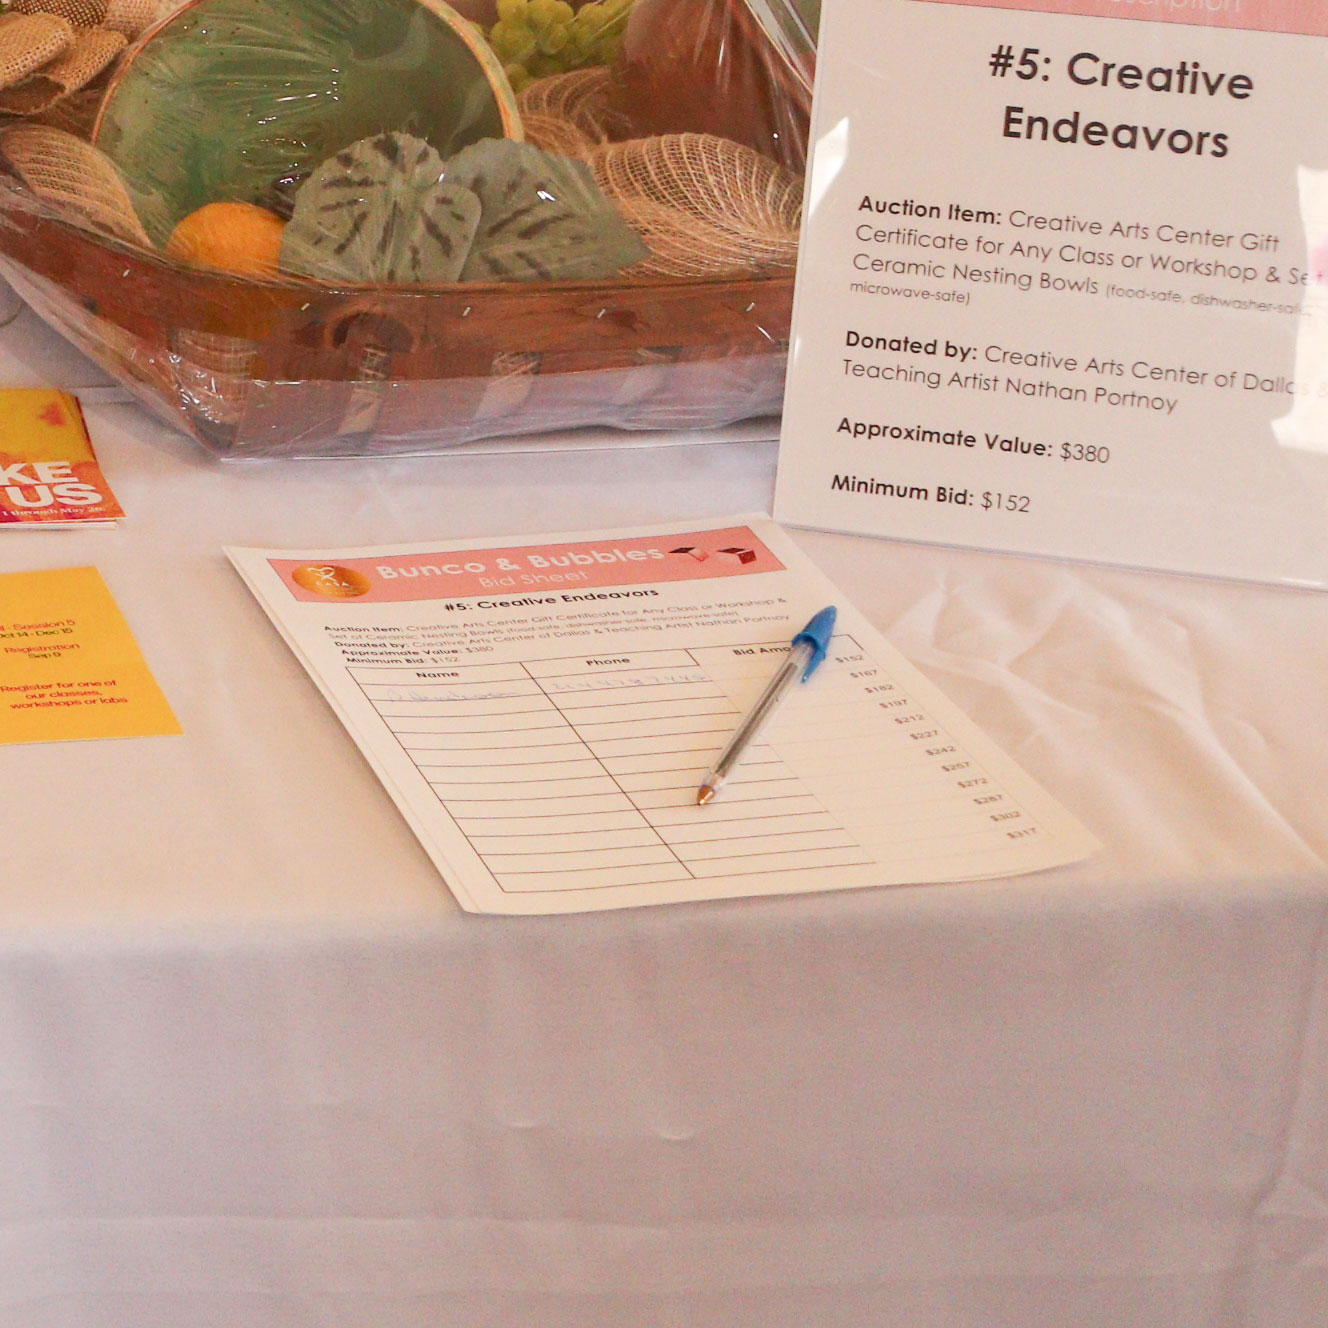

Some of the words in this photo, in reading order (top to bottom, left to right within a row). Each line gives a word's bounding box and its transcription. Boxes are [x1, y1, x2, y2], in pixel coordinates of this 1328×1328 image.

[989, 44, 1050, 81] #5:
[1067, 52, 1253, 100] Creative
[1003, 105, 1230, 158] Endeavors
[858, 196, 941, 219] Auction
[947, 204, 1002, 225] Item:
[1009, 210, 1102, 236] Creative
[1109, 221, 1149, 240] Arts
[1156, 225, 1234, 247] Center
[1240, 233, 1280, 252] Gift
[856, 224, 968, 253] Certificate
[976, 236, 1004, 256] for
[1010, 241, 1051, 264] Any
[1059, 244, 1114, 267] Class
[1121, 255, 1143, 268] or
[1150, 254, 1258, 283] Workshop
[1265, 267, 1281, 283] &
[1287, 268, 1311, 286] Se
[850, 281, 971, 305] microwave-safe)
[853, 254, 945, 279] Ceramic
[952, 263, 1032, 290] Nesting
[1040, 271, 1098, 295] Bowls
[1106, 284, 1185, 304] (food-safe,
[1190, 293, 1312, 316] dishwasher-saf
[846, 331, 937, 356] Donated
[944, 339, 978, 362] by:
[984, 345, 1078, 372] Creative
[1085, 357, 1124, 376] Arts
[1131, 361, 1208, 385] Center
[1214, 372, 1237, 388] of
[842, 360, 941, 389] Teaching
[948, 372, 999, 392] Artist
[1006, 378, 1087, 403] Nathan
[1095, 386, 1179, 415] Portnoy
[837, 417, 977, 448] Approximate
[984, 434, 1053, 457] Value:
[1060, 442, 1111, 465] $380
[3, 483, 103, 508] US
[831, 474, 929, 501] Minimum
[936, 486, 974, 506] Bid:
[981, 491, 1031, 513] $152
[10, 509, 59, 517] through
[60, 507, 85, 515] May
[375, 563, 485, 579] Bunco
[495, 558, 519, 571] &
[527, 547, 665, 569] Bubbles
[479, 576, 515, 588] Bid
[523, 571, 589, 585] Sheet
[444, 602, 473, 611] #5:
[477, 595, 557, 610] Creative
[561, 588, 659, 603] Endeavors
[4, 642, 81, 654] Registration
[733, 648, 755, 656] Bid
[759, 646, 792, 654] Amo
[586, 656, 630, 666] Phone
[0, 683, 53, 692] Register
[416, 671, 460, 679] Name
[10, 699, 82, 710] workshops
